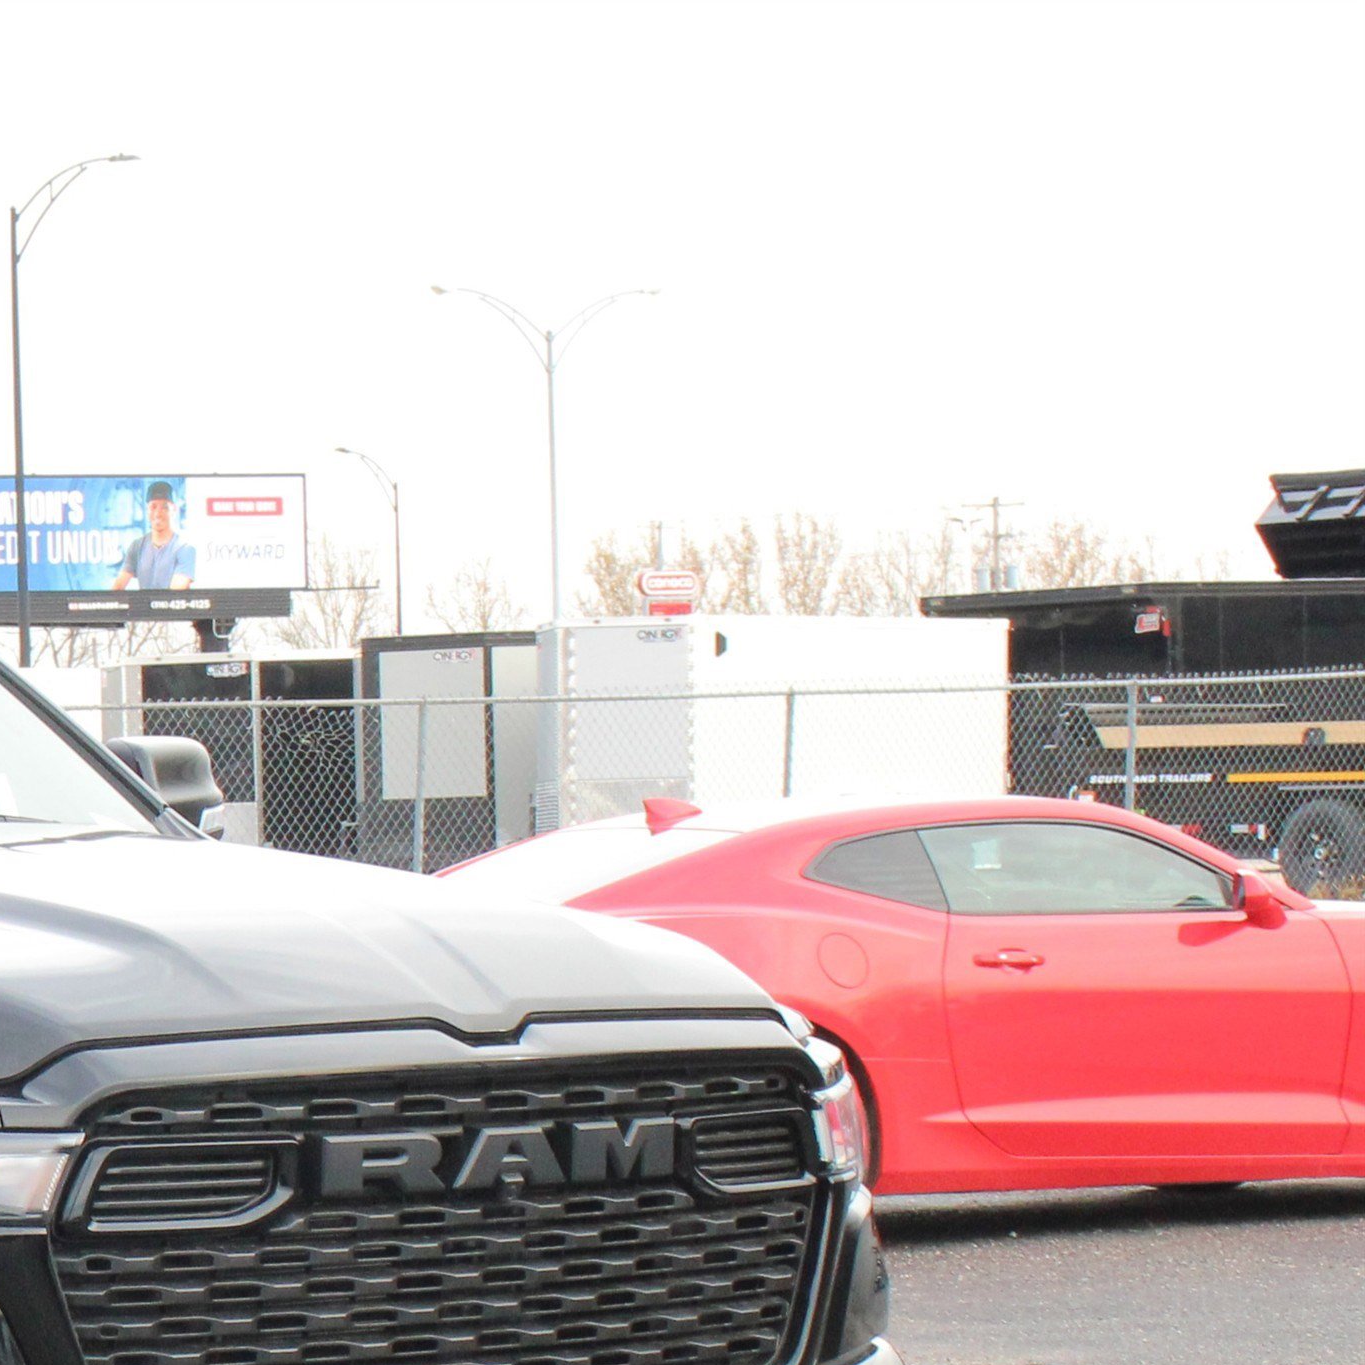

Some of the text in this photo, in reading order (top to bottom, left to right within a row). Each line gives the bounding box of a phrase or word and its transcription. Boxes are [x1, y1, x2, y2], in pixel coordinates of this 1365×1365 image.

[47, 530, 122, 565] UNION
[206, 542, 285, 562] SKYWARD
[1089, 773, 1212, 785] SOUTHAND TRAILERS
[321, 1116, 675, 1198] RAM
